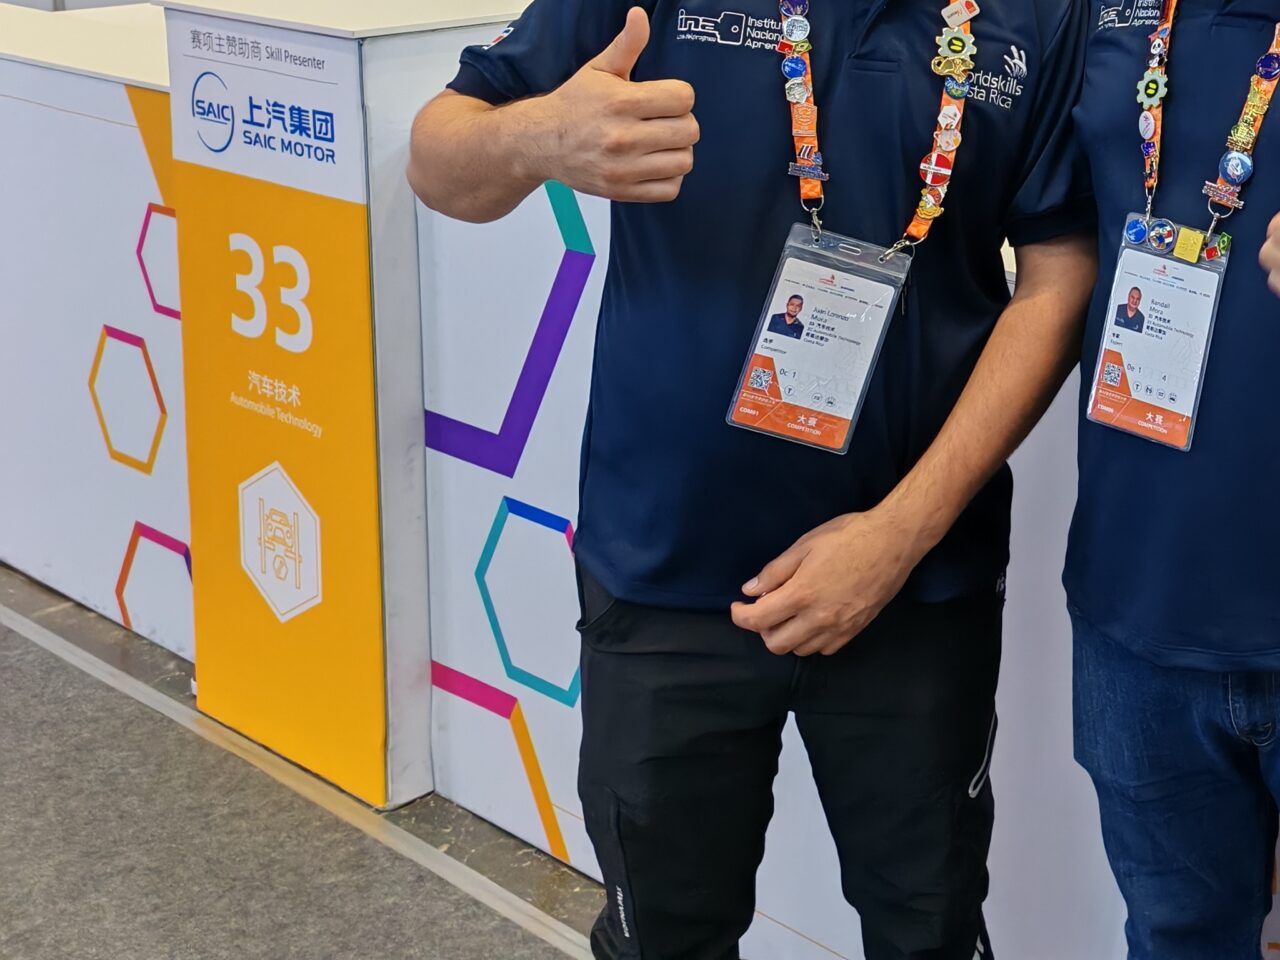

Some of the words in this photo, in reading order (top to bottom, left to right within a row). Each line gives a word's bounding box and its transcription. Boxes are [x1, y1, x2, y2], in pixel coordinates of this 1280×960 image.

[190, 29, 262, 61] 赛项主赞助商
[265, 47, 283, 62] Skill
[284, 50, 326, 71] Presenter
[195, 99, 231, 122] SAIC
[989, 88, 1013, 109] Rica
[242, 95, 335, 143] 上汽集团
[243, 130, 276, 151] SAIC
[281, 140, 336, 164] MOTOR
[228, 232, 314, 353] 33
[248, 370, 302, 408] 汽车技术
[230, 391, 276, 419] Automobile
[275, 406, 323, 439] Technology
